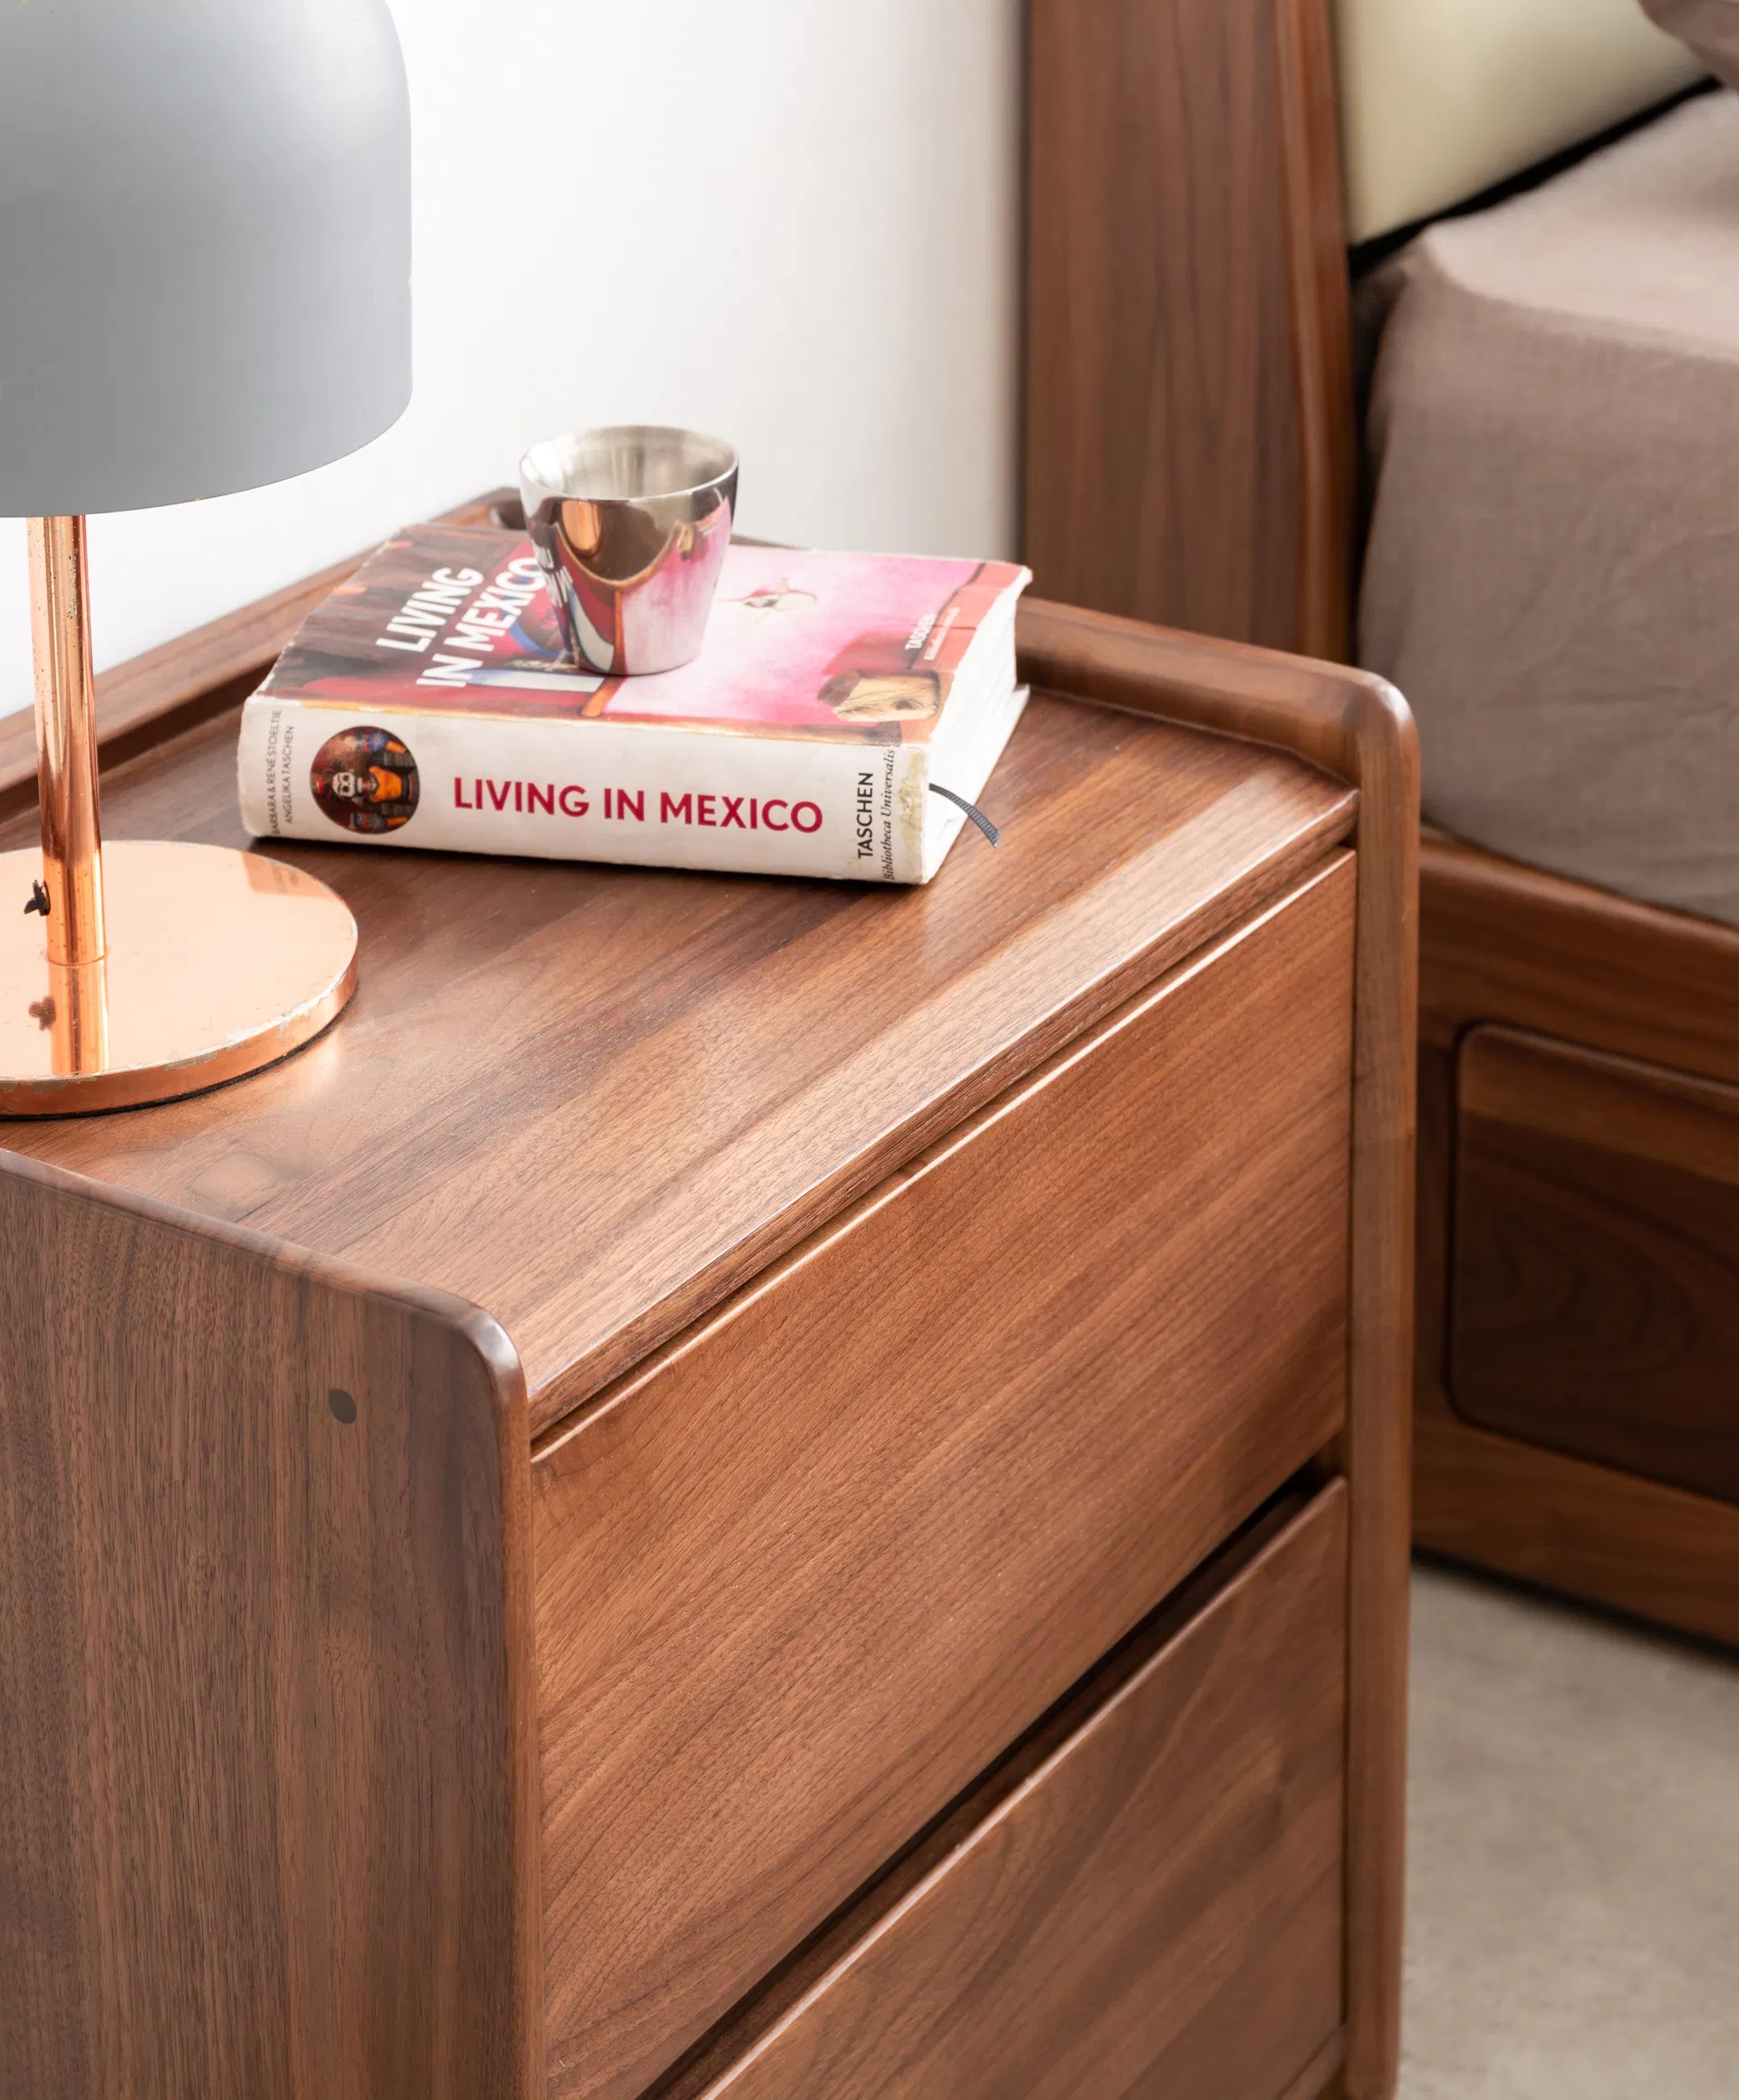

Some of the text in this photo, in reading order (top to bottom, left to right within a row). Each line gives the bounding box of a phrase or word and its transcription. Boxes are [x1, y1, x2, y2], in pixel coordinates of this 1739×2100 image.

[375, 567, 485, 653] LIVING
[416, 557, 547, 688] IN MEXICO
[266, 709, 282, 756] STOELTIE
[282, 725, 294, 824] ANGELIKA TASCHEN
[454, 777, 824, 834] LIVING IN MEXICO
[856, 772, 874, 859] TASCHEN
[880, 750, 896, 881] Bibliotheca Universalis
